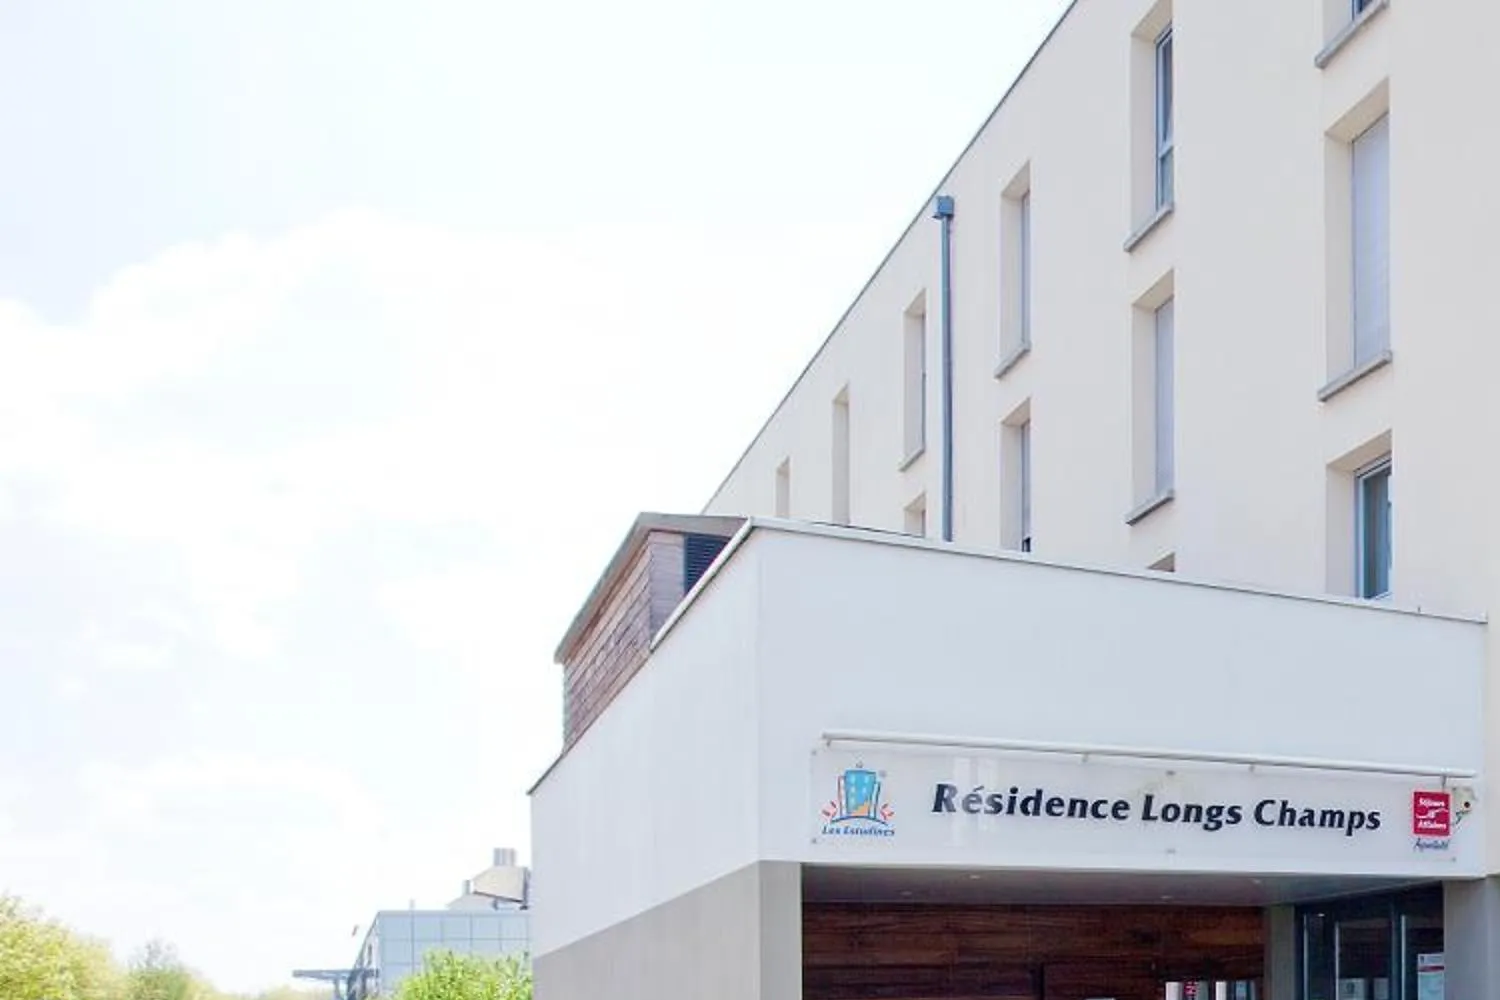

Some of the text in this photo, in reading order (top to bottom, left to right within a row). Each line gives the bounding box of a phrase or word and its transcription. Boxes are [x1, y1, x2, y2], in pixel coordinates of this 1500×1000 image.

[931, 783, 1382, 836] Résidence Longs Champs
